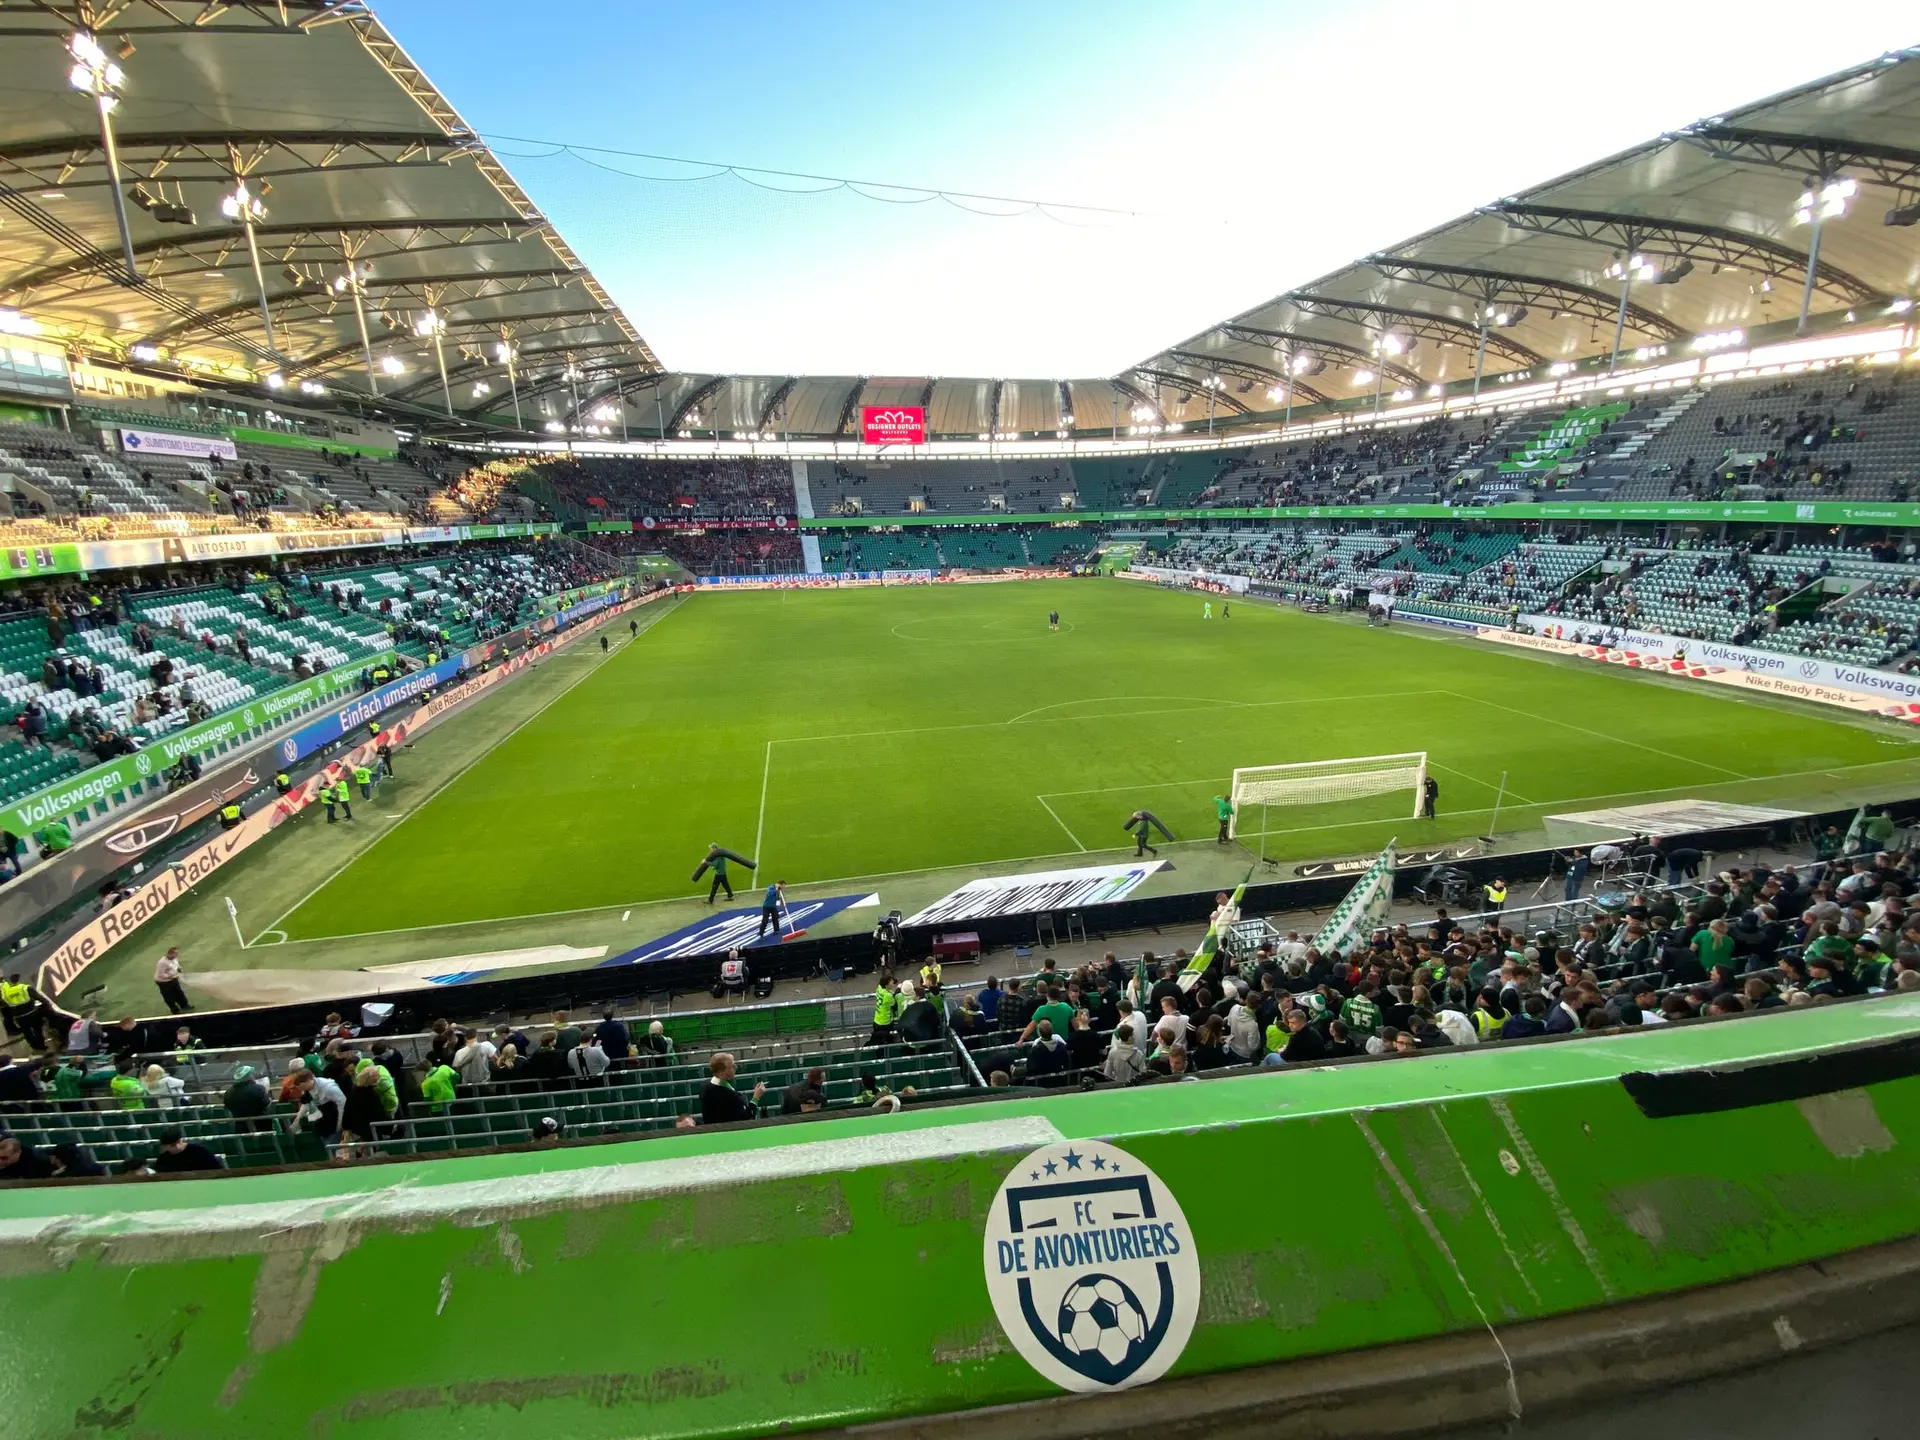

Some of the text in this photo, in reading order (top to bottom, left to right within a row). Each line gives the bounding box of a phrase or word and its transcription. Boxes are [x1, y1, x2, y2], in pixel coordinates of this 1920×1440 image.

[144, 436, 182, 450] SUMITOMO
[183, 442, 213, 453] ELECTRIC
[1479, 483, 1520, 491] FUSSBALL
[192, 541, 247, 554] AUTOSTADT
[719, 576, 736, 584] Der
[1500, 633, 1559, 650] Nike Ready Pack
[1701, 644, 1785, 670] Volkswagen
[262, 686, 313, 716] Volkswagen
[339, 671, 438, 732] Einfach umsteigen
[427, 678, 481, 718] Nike Ready Pack
[1745, 675, 1846, 702] Nike Ready Pack
[162, 720, 235, 760] Volkswagen
[16, 770, 122, 827] Volkswagen
[44, 845, 222, 996] Nike Ready Pack
[1074, 1200, 1096, 1226] FC
[997, 1222, 1181, 1274] DE AVONTURIERS
